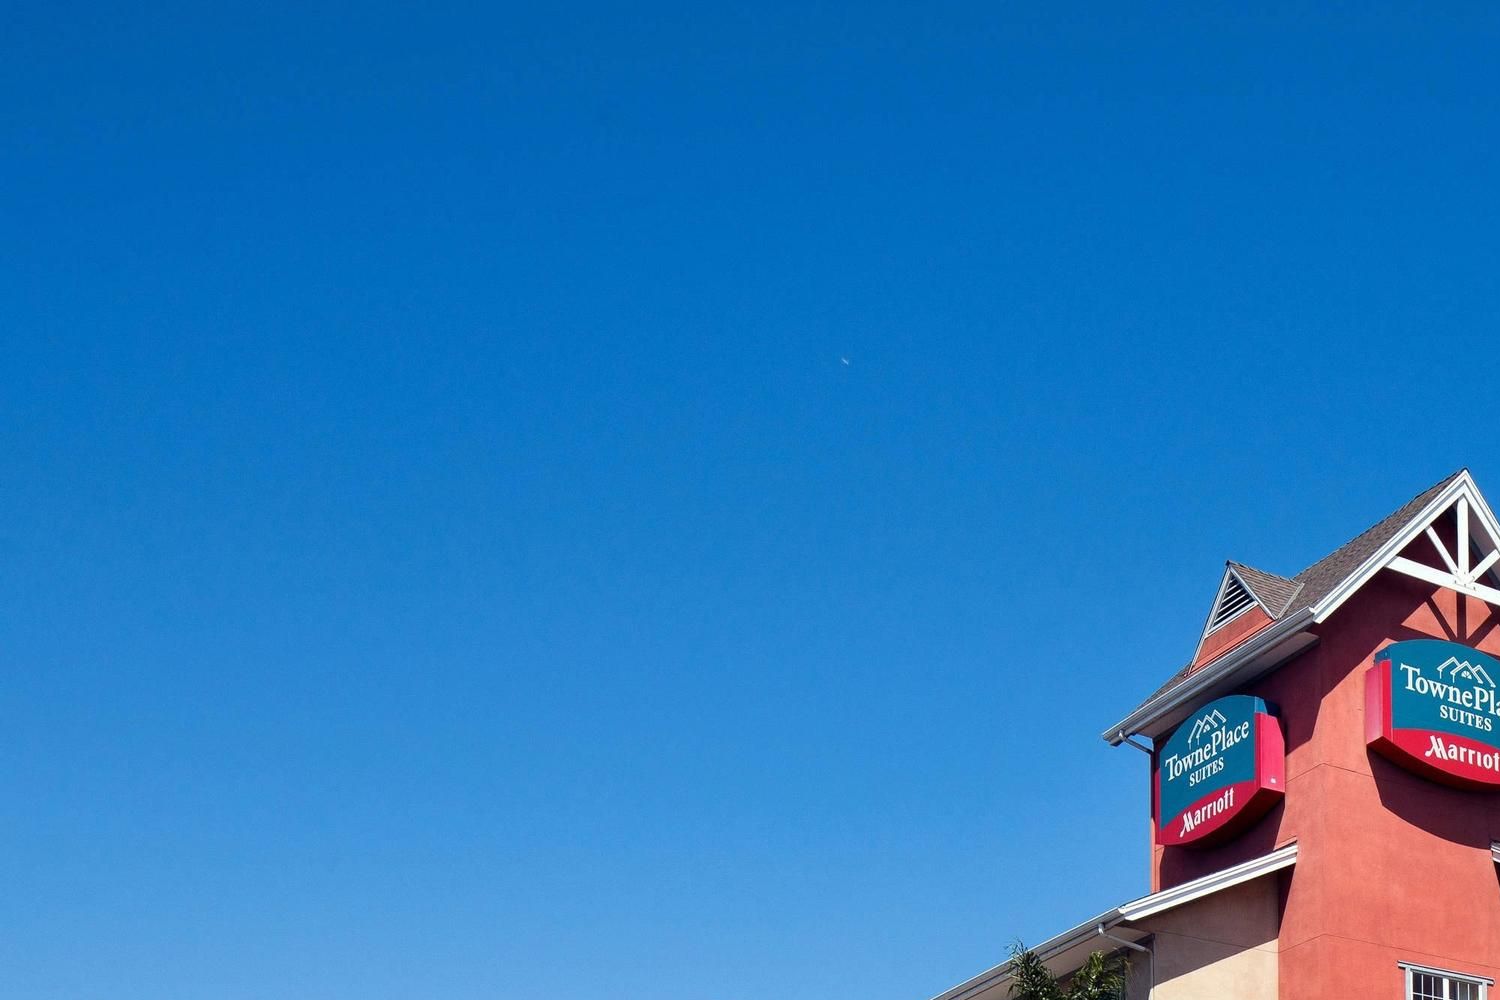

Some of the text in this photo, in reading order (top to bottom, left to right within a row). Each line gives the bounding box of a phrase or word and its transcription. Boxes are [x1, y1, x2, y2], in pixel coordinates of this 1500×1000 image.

[1439, 703, 1493, 732] SUITES
[1165, 719, 1250, 782] TownePlace
[1189, 757, 1225, 787] SUITES
[1180, 787, 1235, 838] Marriott
